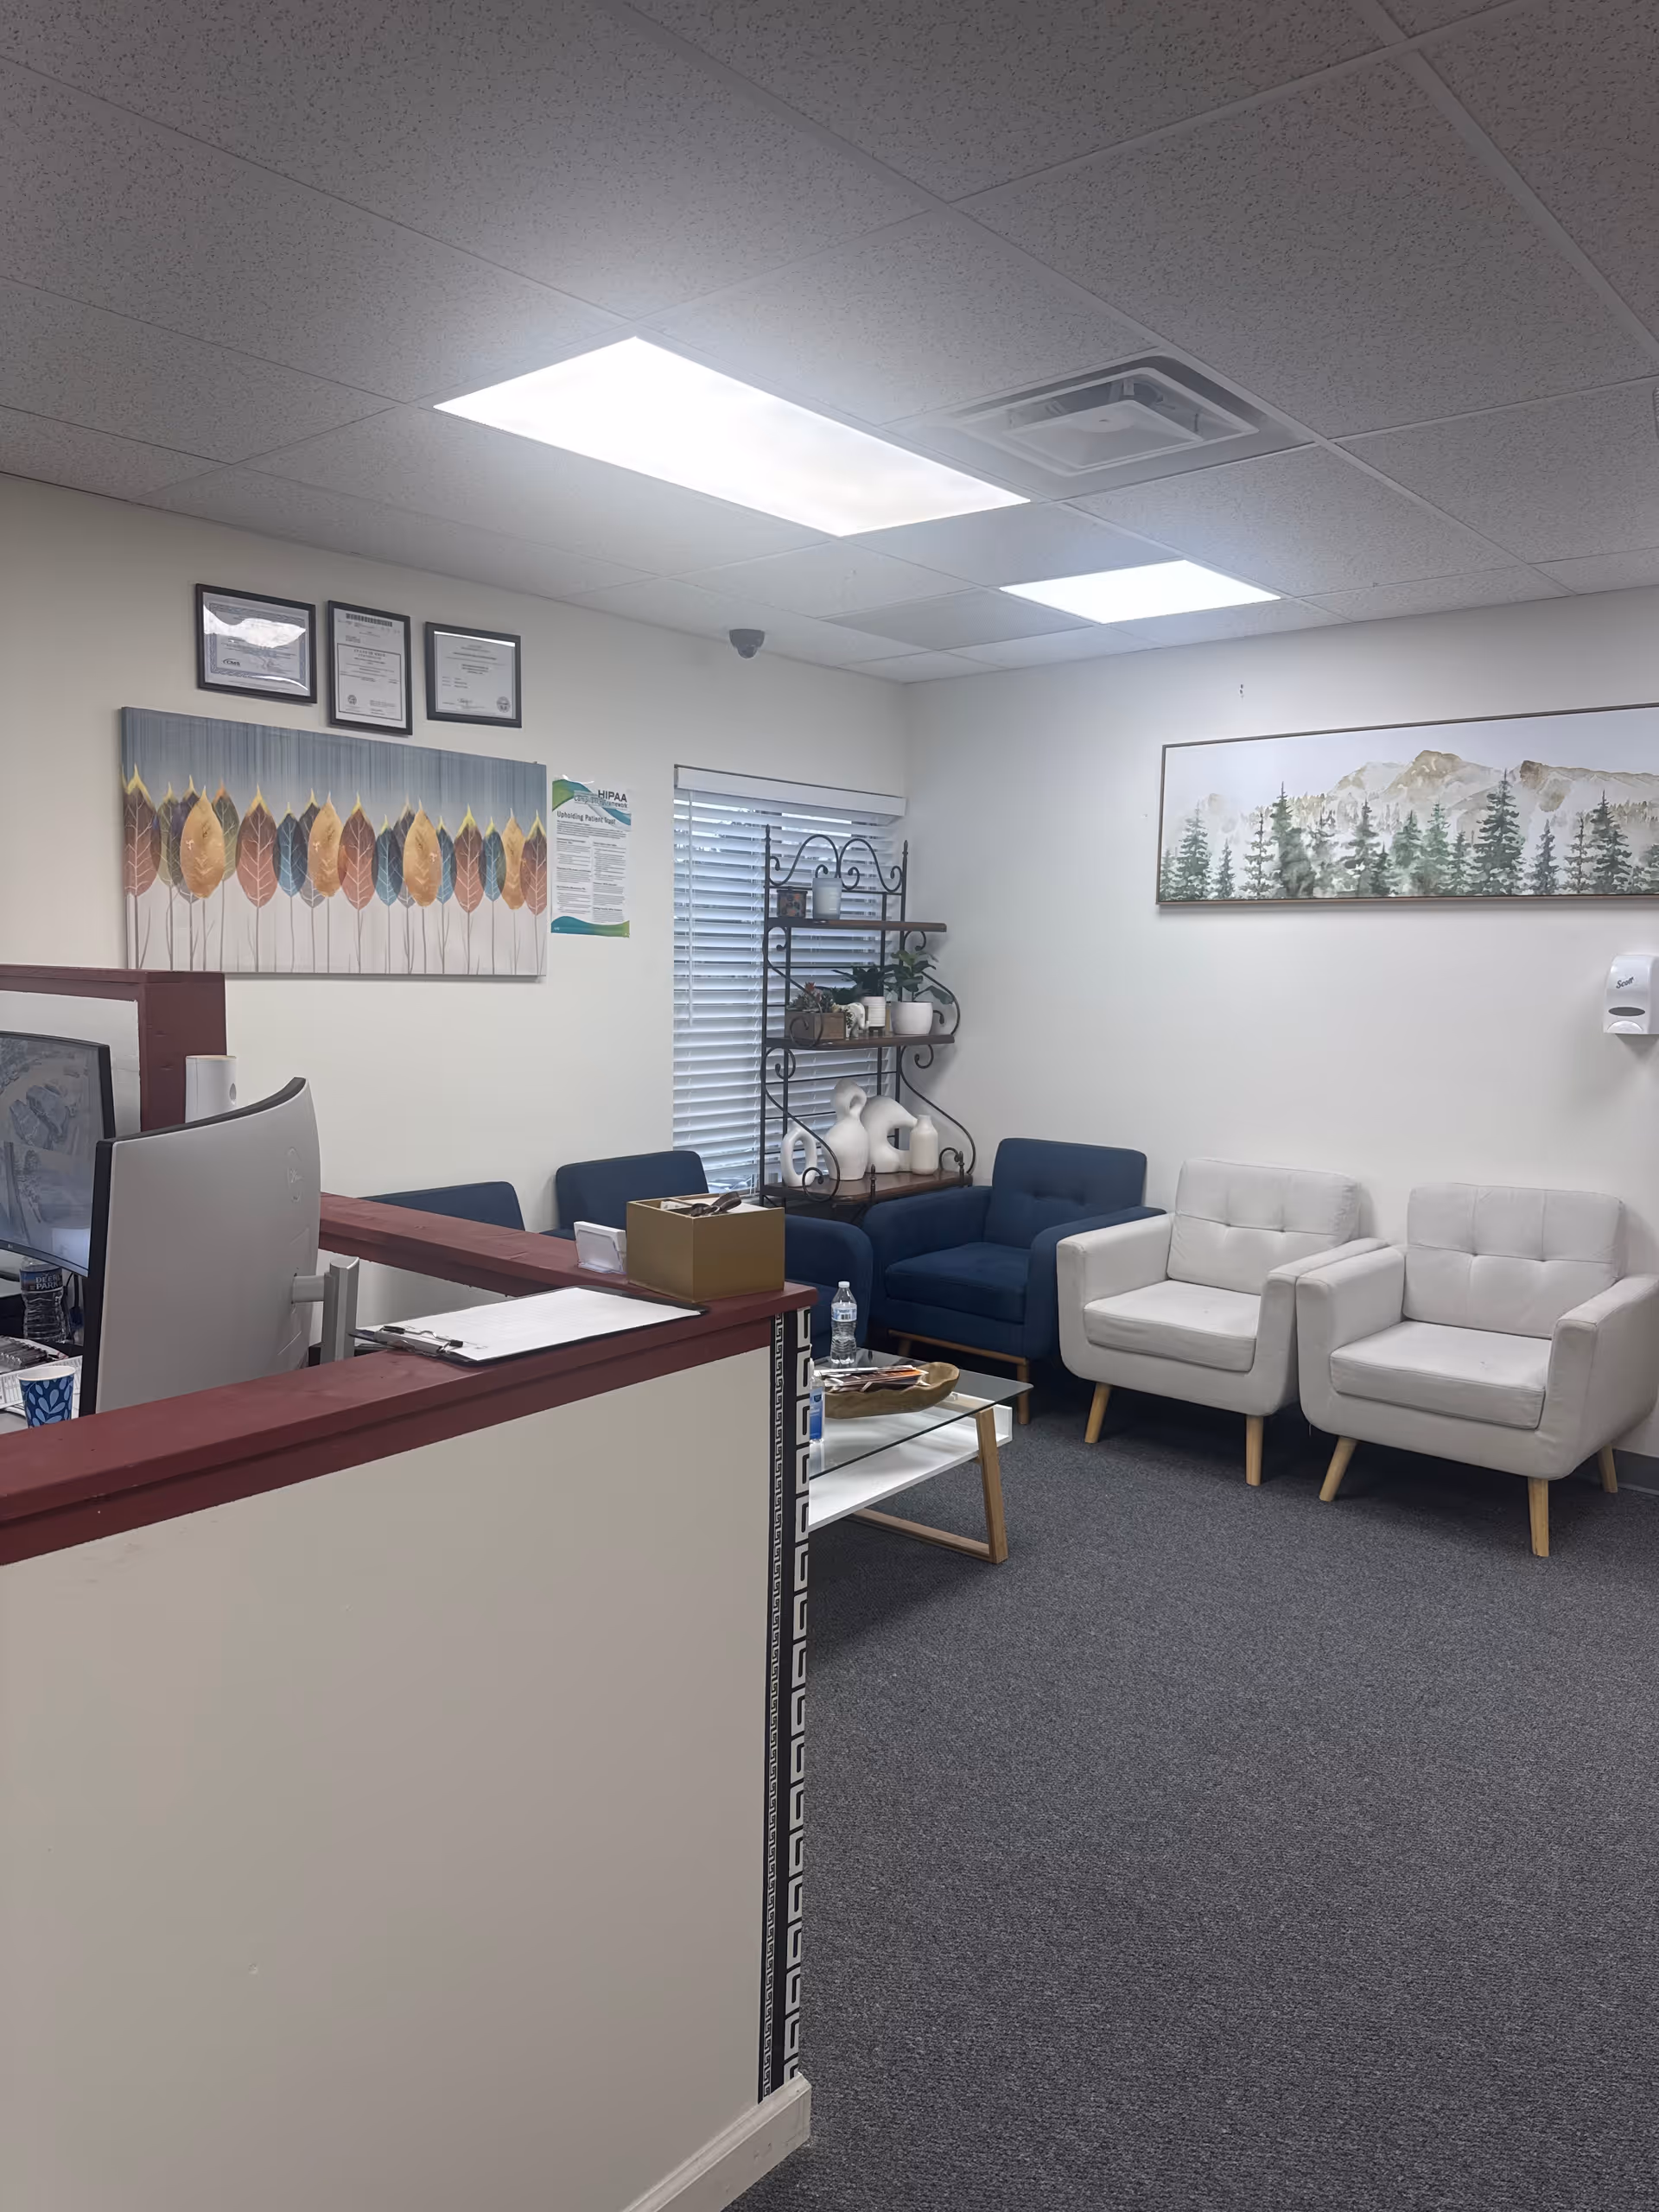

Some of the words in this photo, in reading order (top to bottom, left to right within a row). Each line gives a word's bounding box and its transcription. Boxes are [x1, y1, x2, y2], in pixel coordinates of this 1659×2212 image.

[598, 790, 627, 802] HIPAA
[557, 810, 583, 821] Upholding
[585, 814, 603, 823] Patient
[604, 817, 615, 825] Trust
[1616, 976, 1634, 988] Scott
